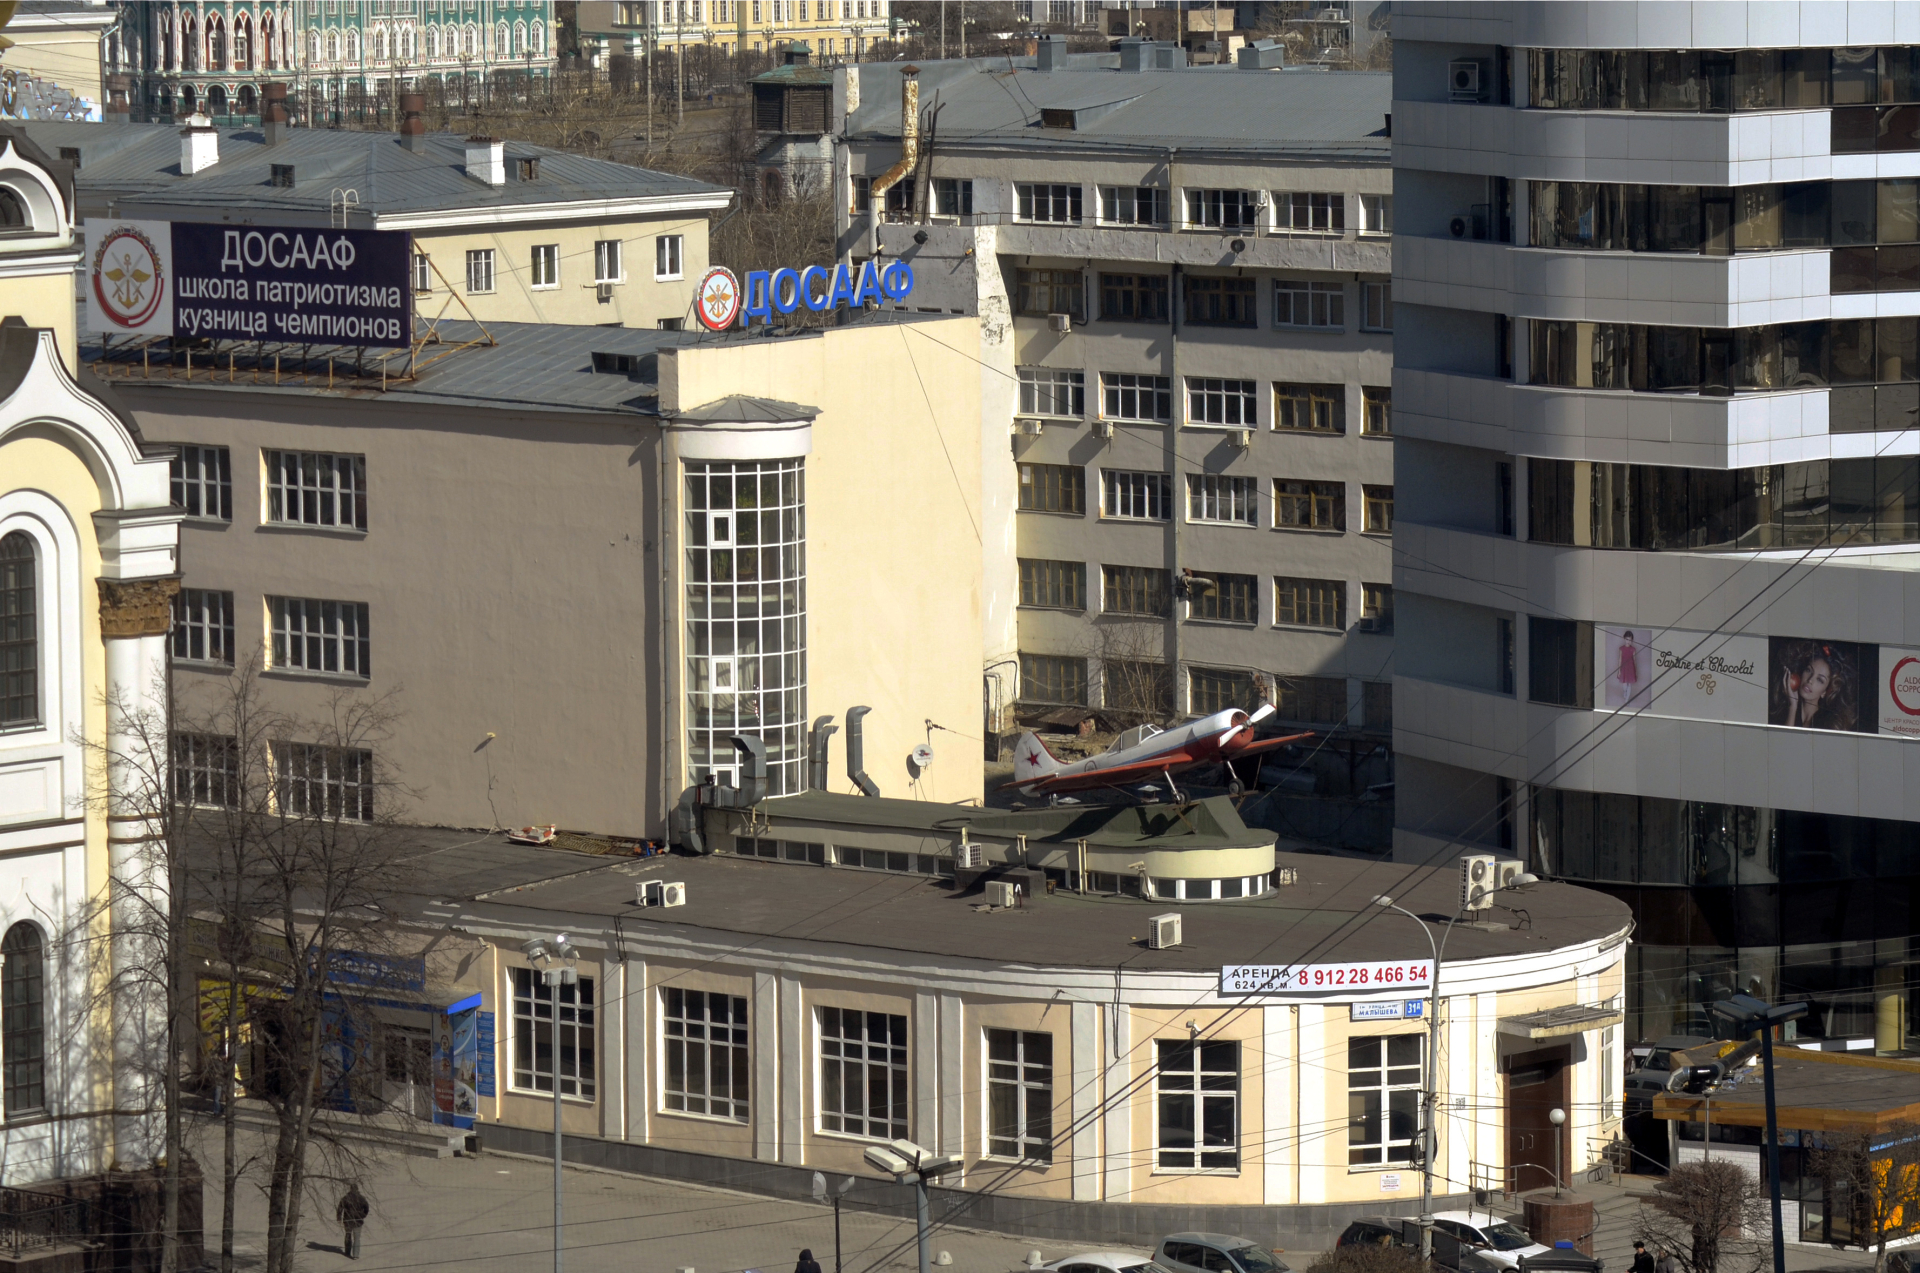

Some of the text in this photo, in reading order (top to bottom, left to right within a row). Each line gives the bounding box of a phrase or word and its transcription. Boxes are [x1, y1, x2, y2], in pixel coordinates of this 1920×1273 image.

[221, 231, 356, 273] ДОСААФ
[179, 277, 401, 309] школа патриотизма
[739, 259, 914, 327] ДОСААФ
[179, 308, 401, 340] кузница чемпионов
[1656, 651, 1754, 675] Tartine et Chocolat
[1232, 968, 1290, 979] АРЕНДА
[1235, 980, 1256, 989] 624
[1299, 966, 1427, 985] 8 912 28 466 54
[1358, 1008, 1398, 1016] МАЛЫШЕВА
